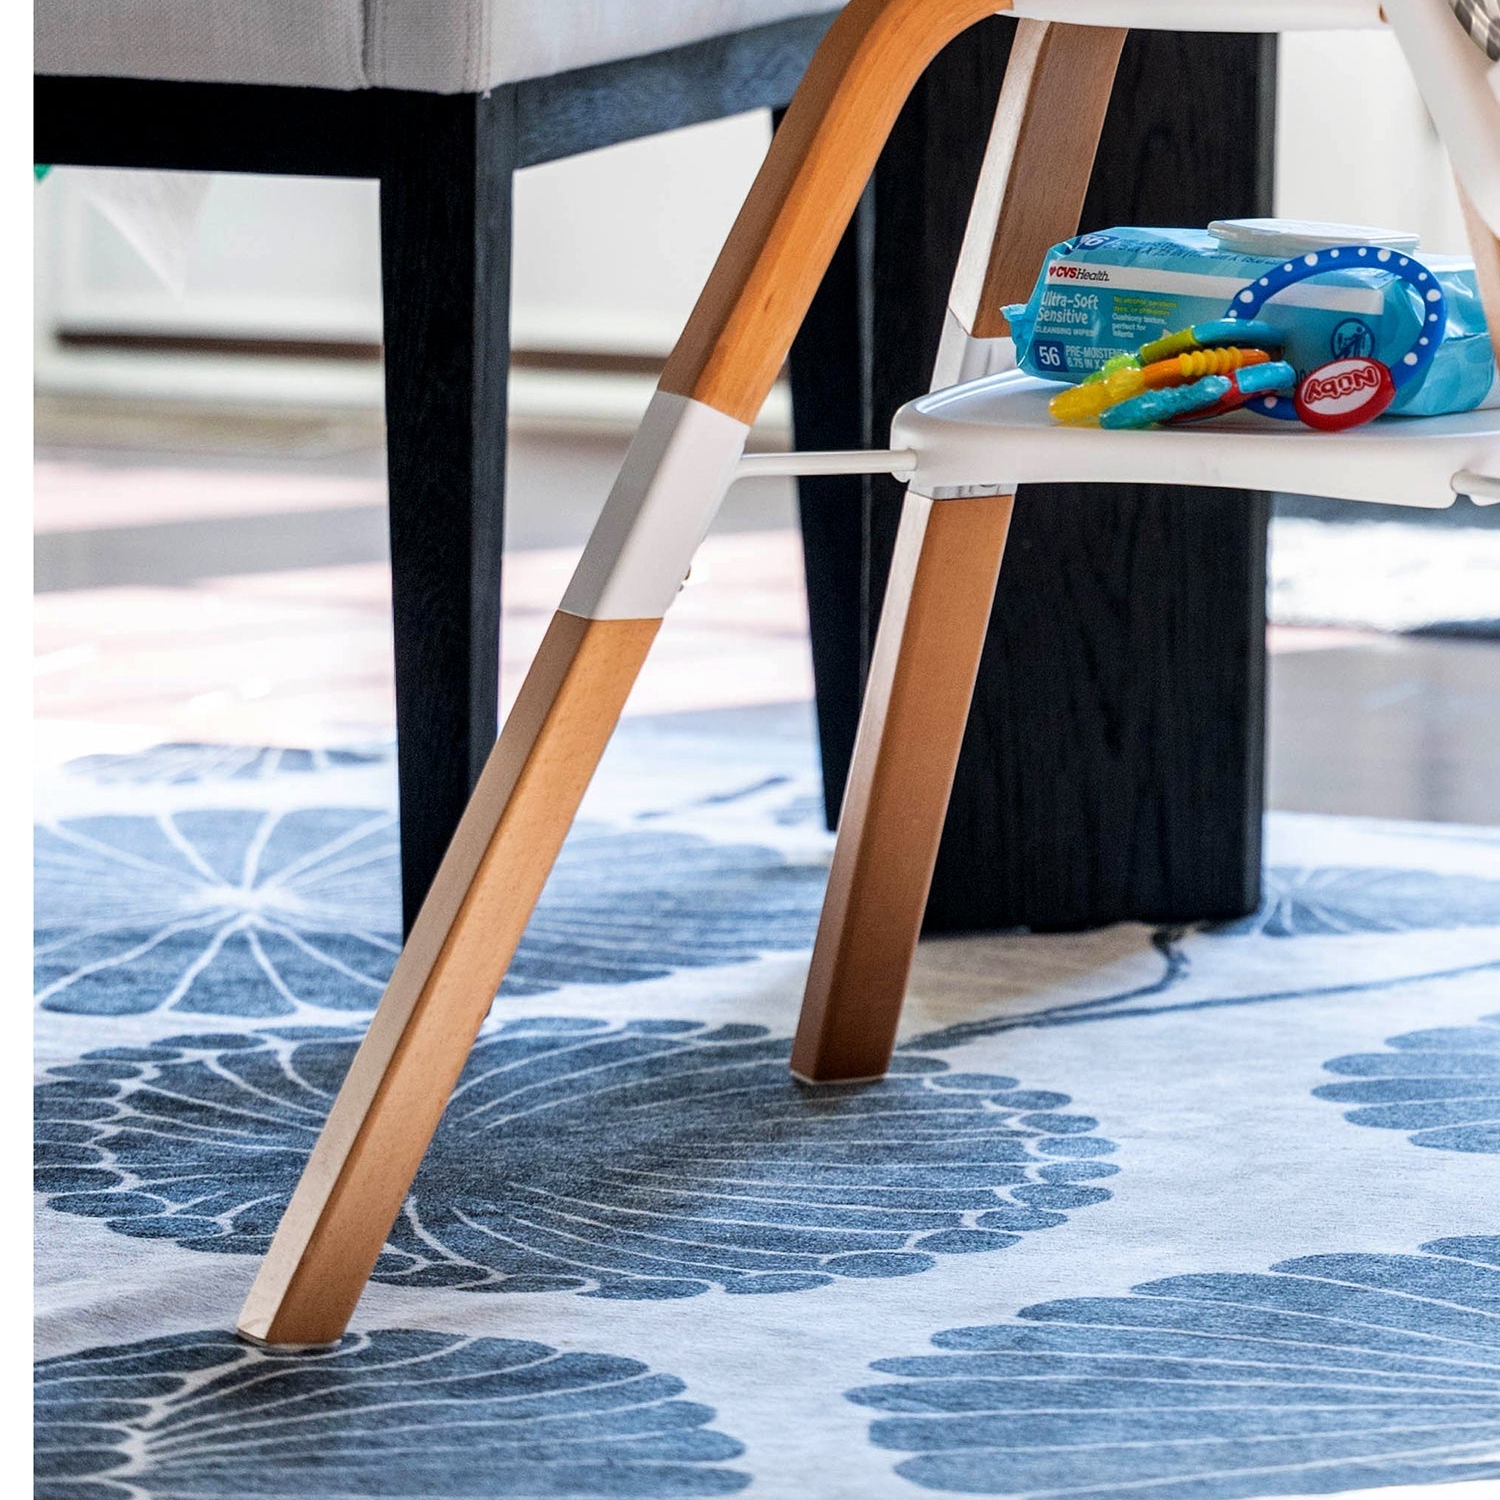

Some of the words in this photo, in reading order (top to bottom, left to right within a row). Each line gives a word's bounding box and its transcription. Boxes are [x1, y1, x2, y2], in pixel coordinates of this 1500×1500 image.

[1041, 290, 1099, 310] Ultra-Soft
[1037, 307, 1088, 324] Sensitive
[1039, 346, 1060, 367] 56
